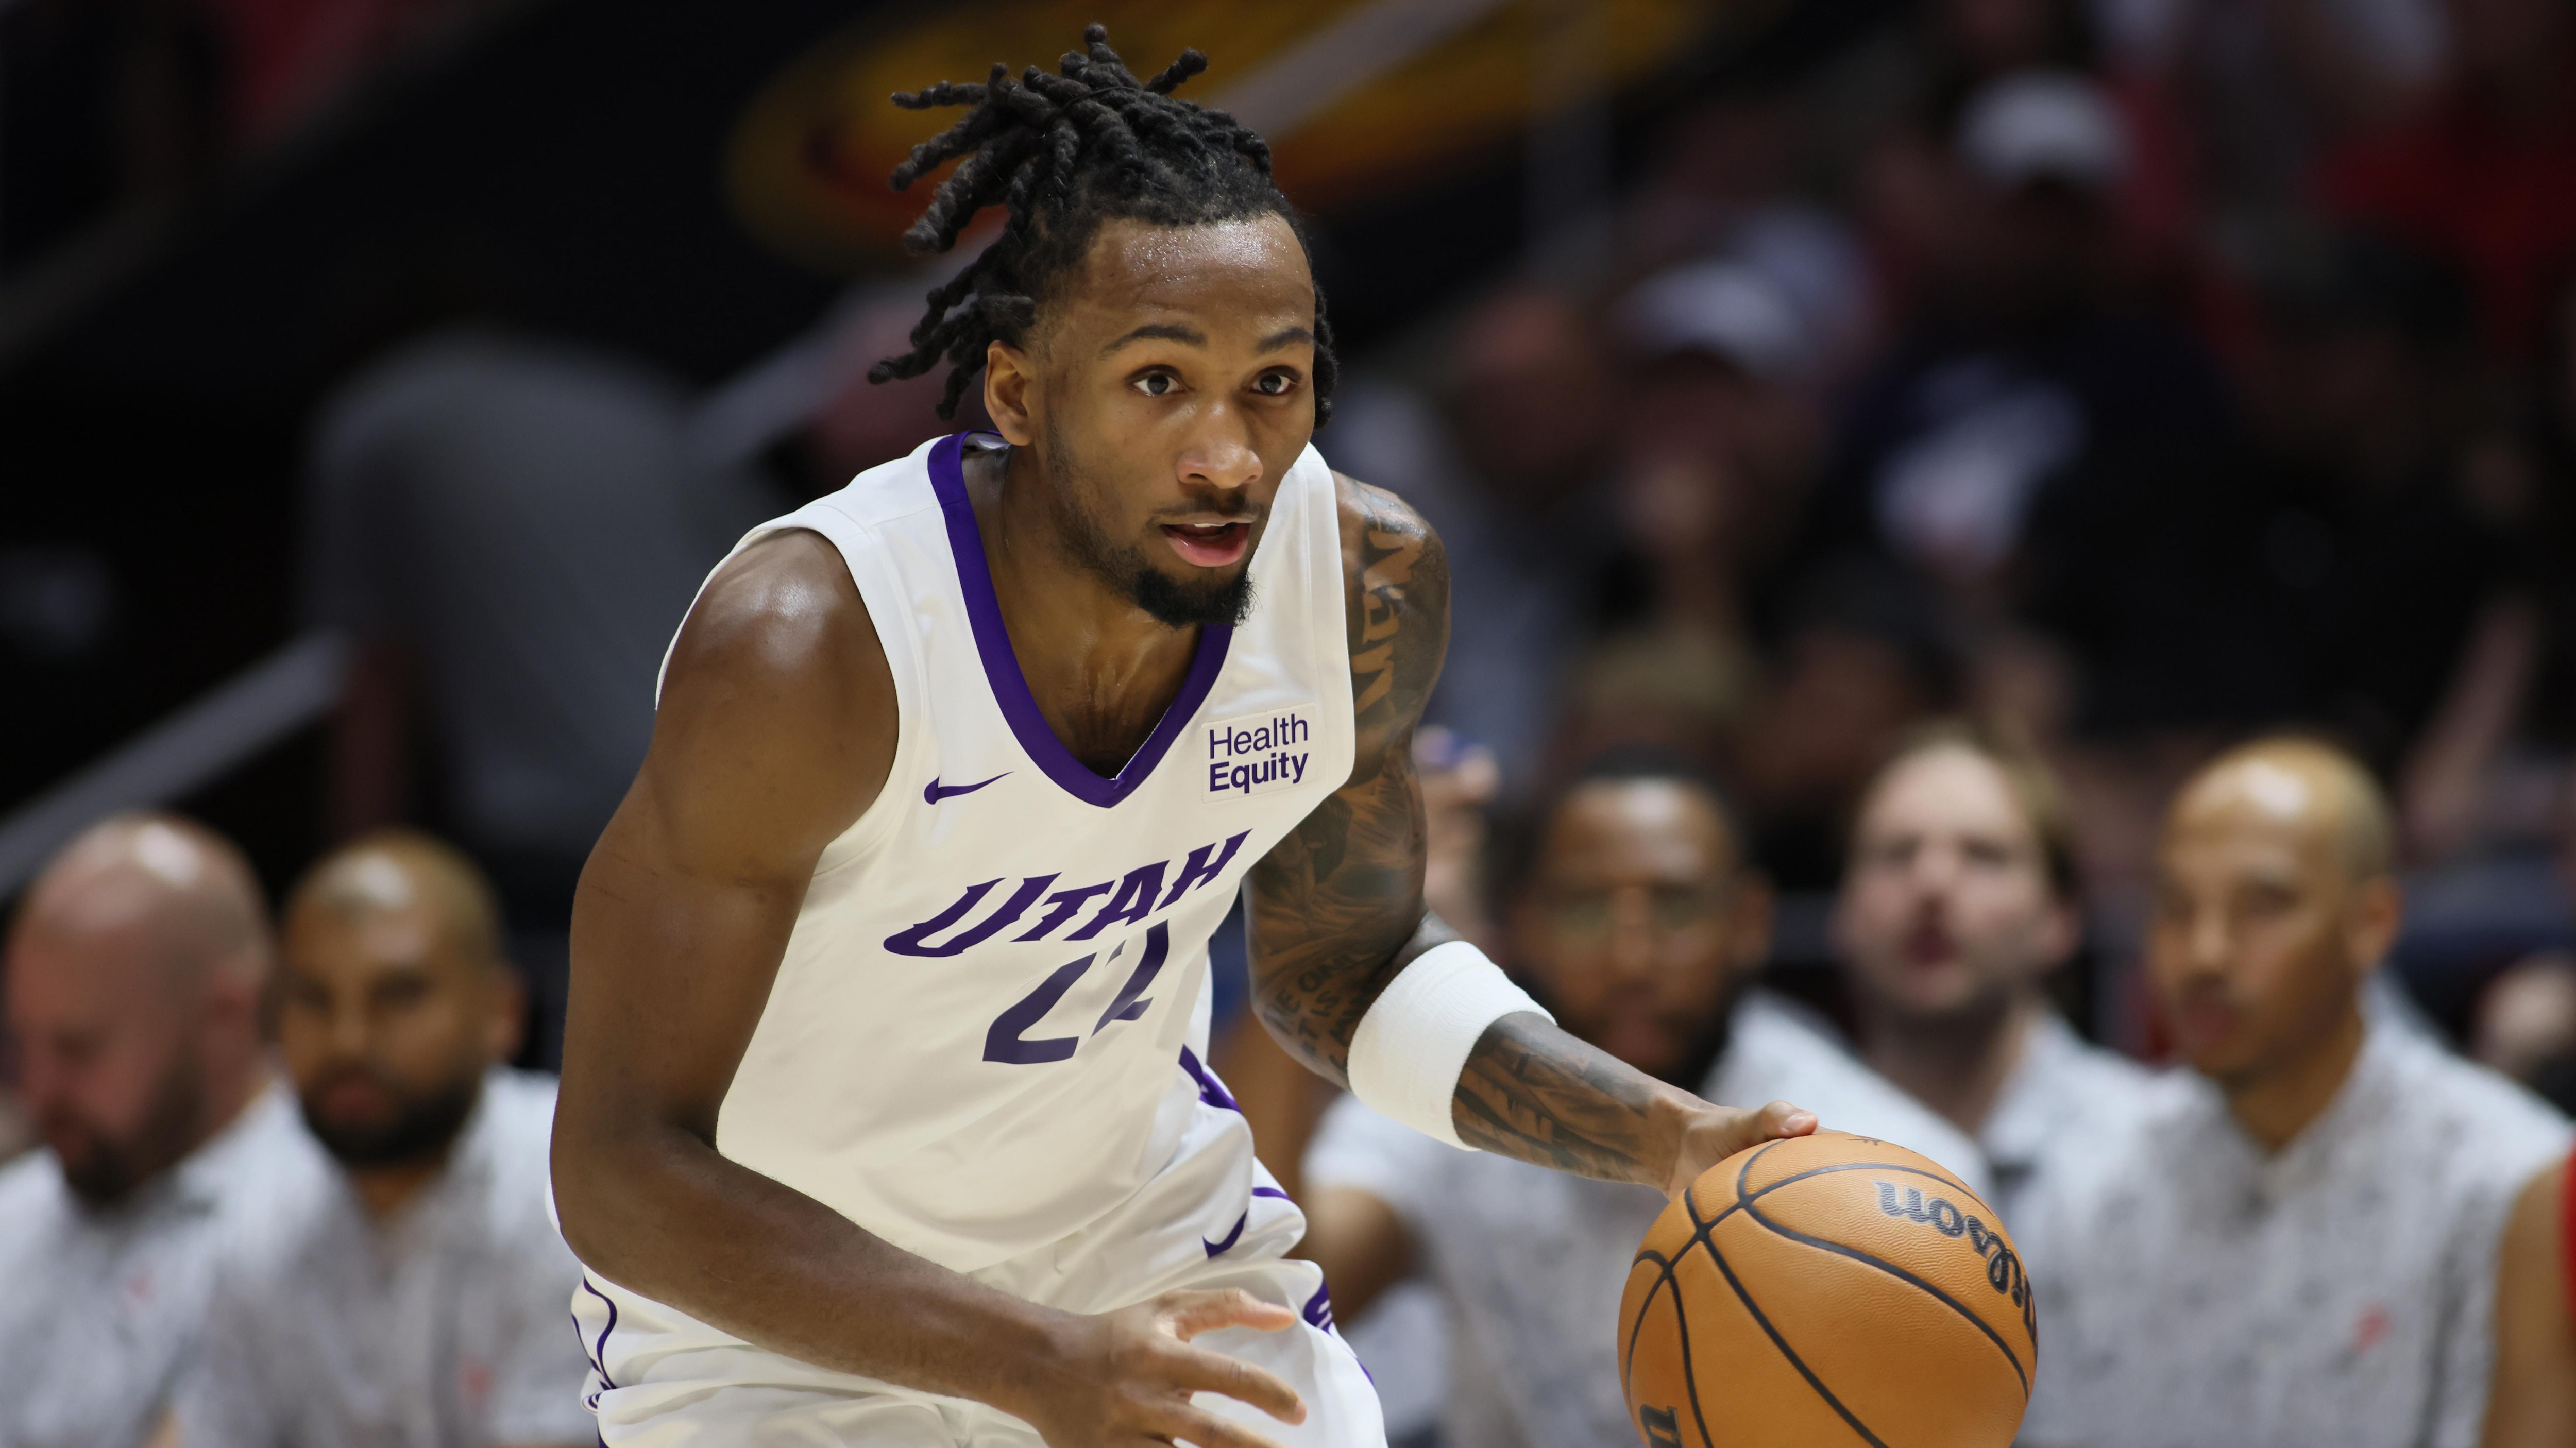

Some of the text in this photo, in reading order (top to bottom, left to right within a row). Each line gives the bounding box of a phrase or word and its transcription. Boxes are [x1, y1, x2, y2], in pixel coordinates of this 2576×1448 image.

[1209, 713, 1308, 759] Health
[1209, 751, 1309, 794] Equity
[883, 828, 1253, 958] UTAH
